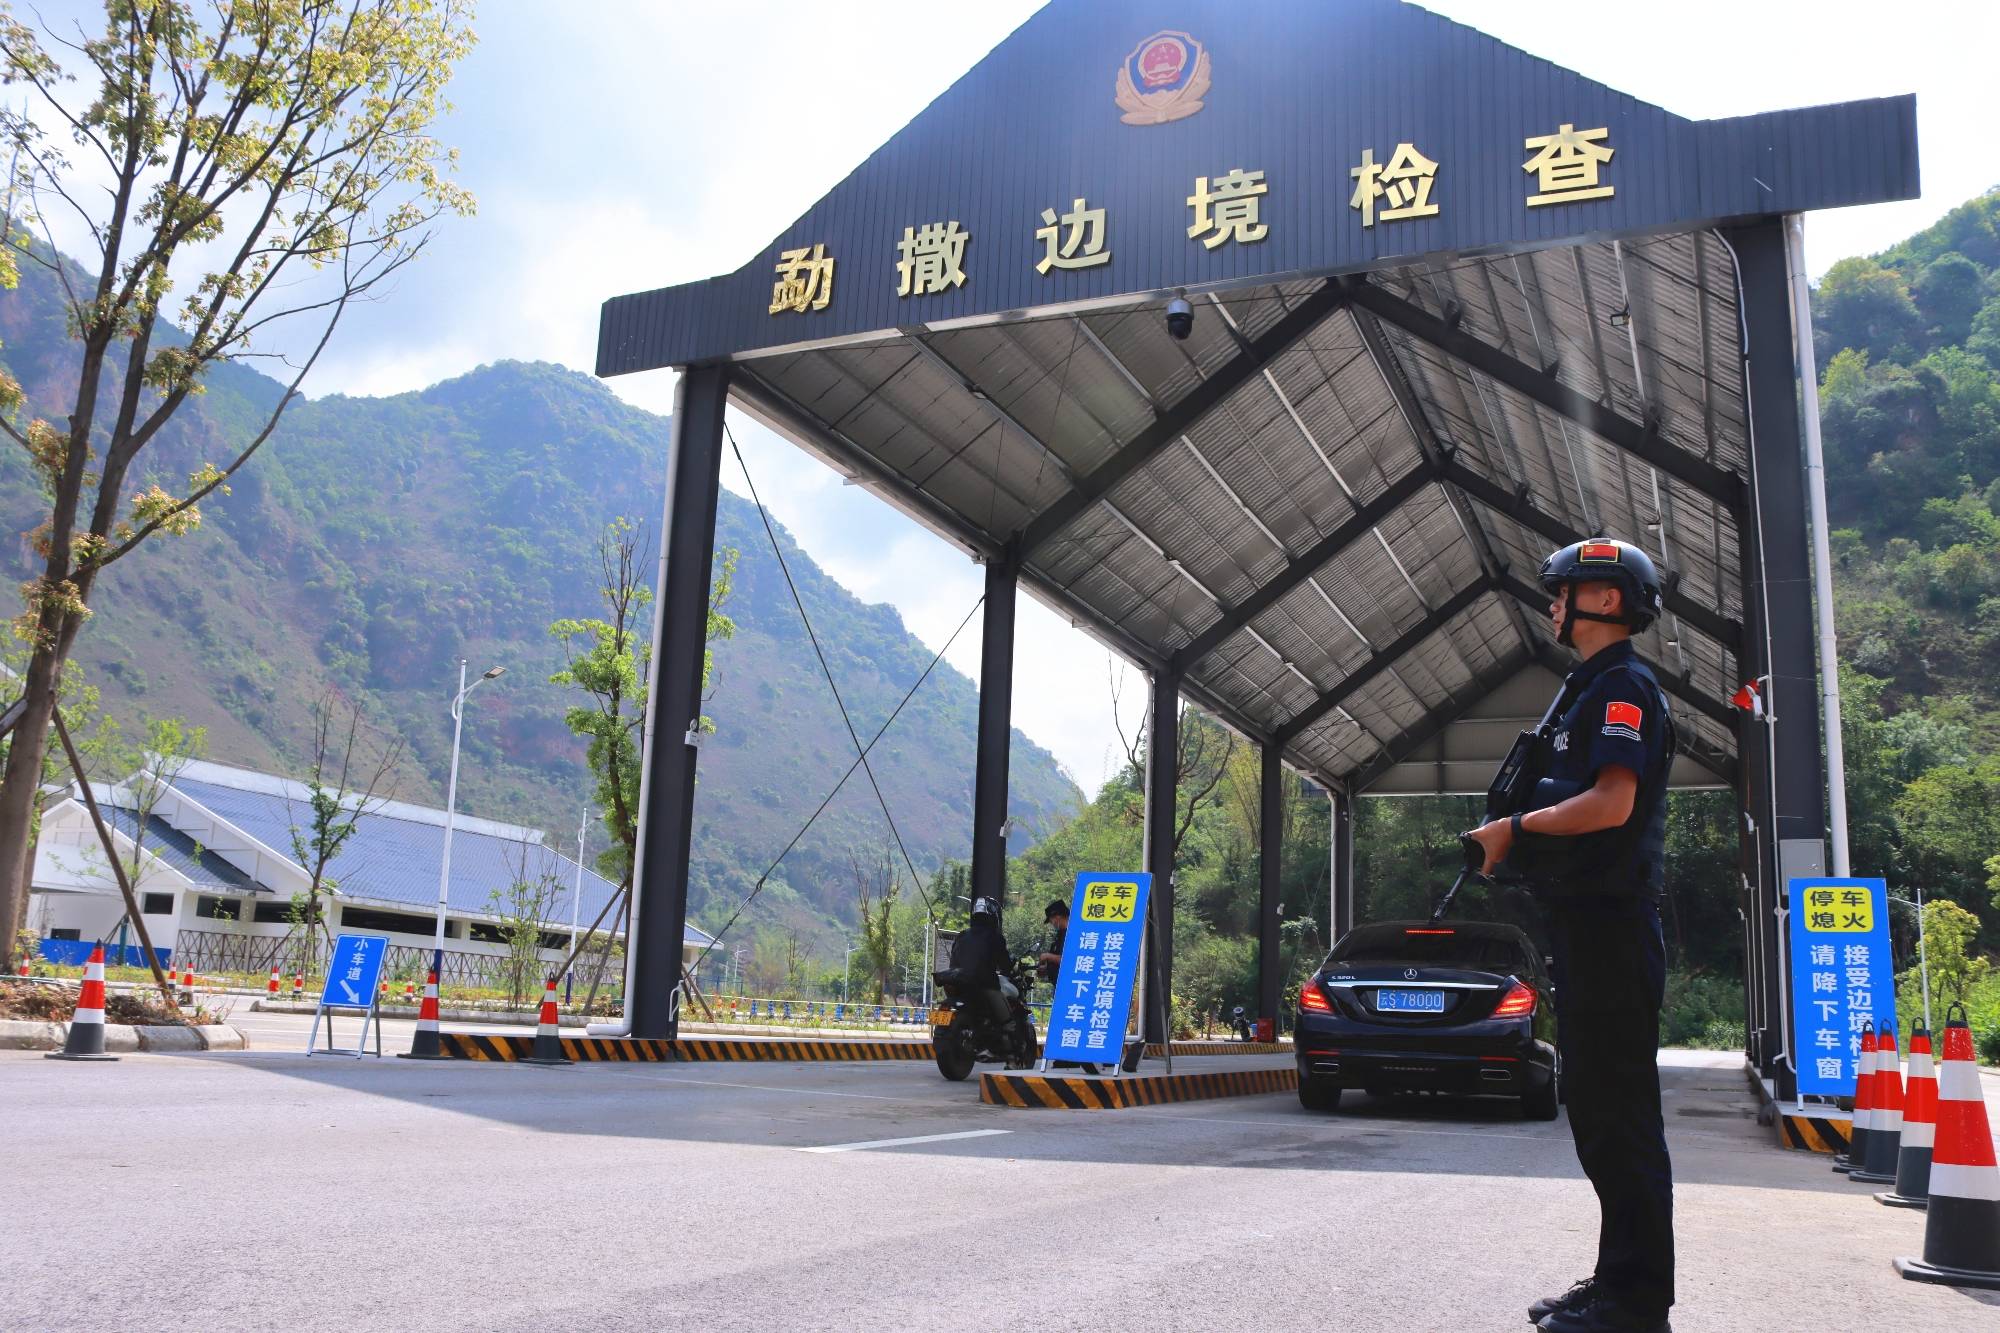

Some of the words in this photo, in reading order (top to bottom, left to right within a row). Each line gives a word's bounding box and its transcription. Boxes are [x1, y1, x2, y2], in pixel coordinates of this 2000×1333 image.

[769, 124, 1615, 314] 勐撒边境检查
[1086, 904, 1129, 918] 熄火
[1090, 885, 1132, 899] 停车
[1810, 890, 1865, 907] 停车
[1811, 912, 1866, 928] 熄火
[346, 938, 369, 981] 小车道
[1061, 931, 1099, 1048] 请降下车窗
[1086, 932, 1125, 1049] 接受边境检查
[1810, 944, 1842, 1080] 请降下车窗
